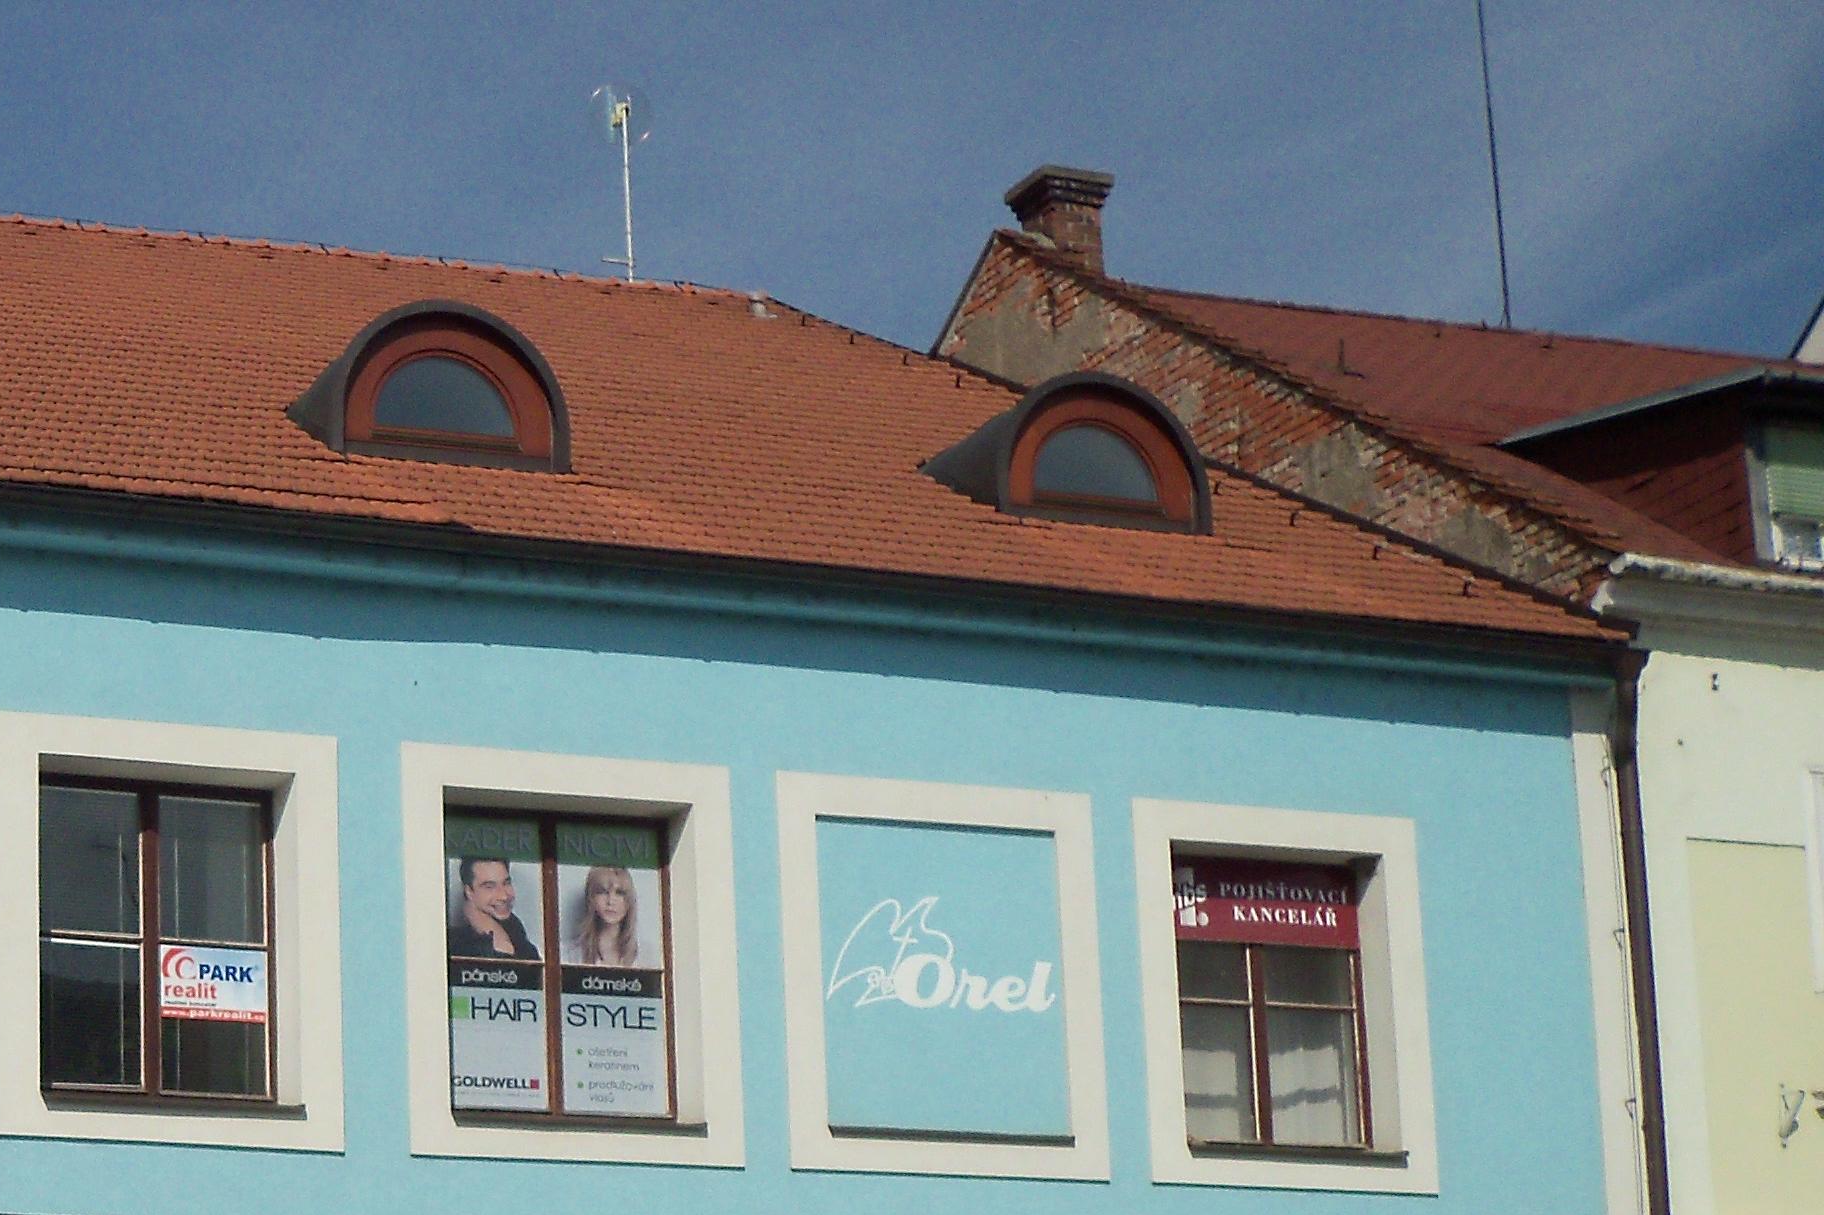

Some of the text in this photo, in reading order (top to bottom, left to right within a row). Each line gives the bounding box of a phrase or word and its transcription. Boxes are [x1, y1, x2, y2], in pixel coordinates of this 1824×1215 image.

[1219, 880, 1349, 906] POJIŠŤOVACÍ
[1233, 904, 1337, 928] KANCELÁŘ
[199, 964, 254, 983] PARK
[462, 968, 518, 984] pánské
[582, 976, 642, 992] dámské
[893, 952, 1056, 1013] Orel
[164, 983, 217, 999] realit
[471, 997, 537, 1022] HAIR
[567, 1003, 657, 1031] STYLE
[453, 1075, 530, 1089] GOLDWELL
